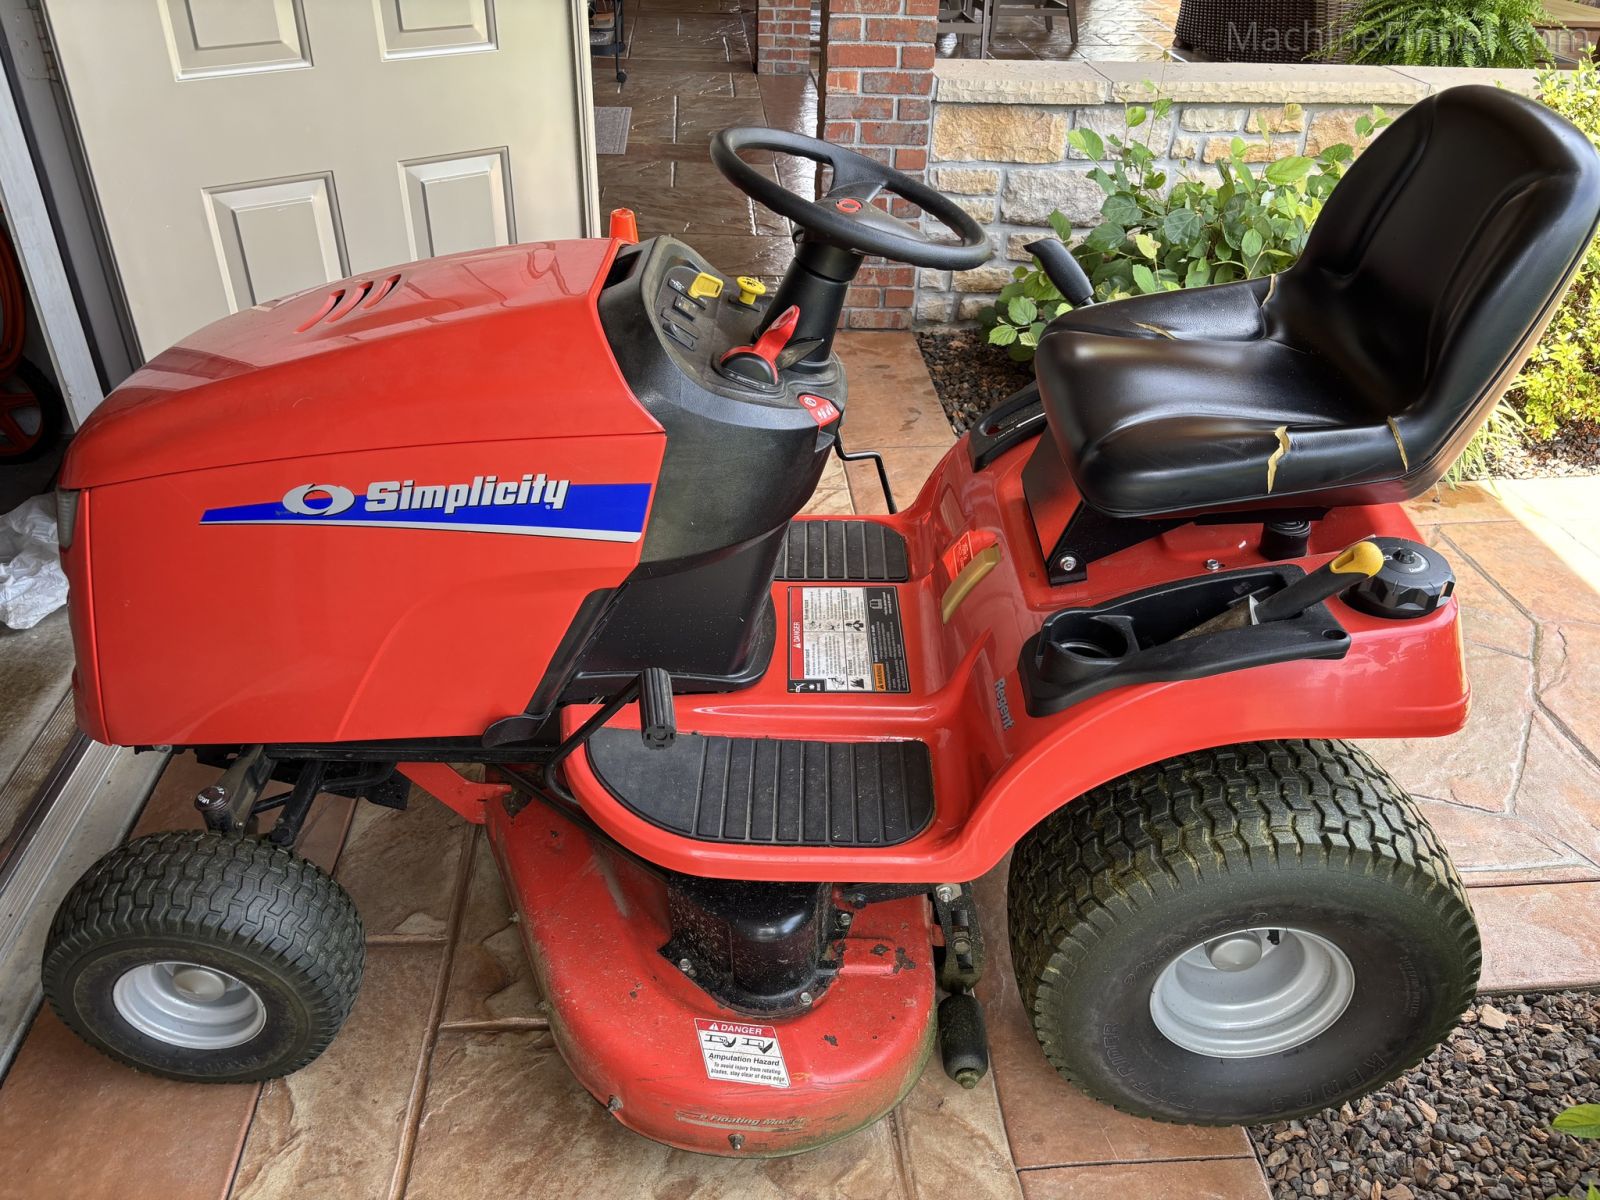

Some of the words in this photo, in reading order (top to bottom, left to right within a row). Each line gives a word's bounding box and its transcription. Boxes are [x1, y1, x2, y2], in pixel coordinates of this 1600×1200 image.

[364, 473, 570, 514] Simplicity
[994, 677, 1015, 730] Regent
[720, 1023, 762, 1035] DANGER
[708, 1052, 752, 1063] Amputation
[753, 1057, 780, 1067] Hazard
[730, 1070, 740, 1078] stay
[734, 1064, 749, 1072] injury
[762, 1067, 781, 1076] rotating
[710, 1114, 761, 1127] Floating
